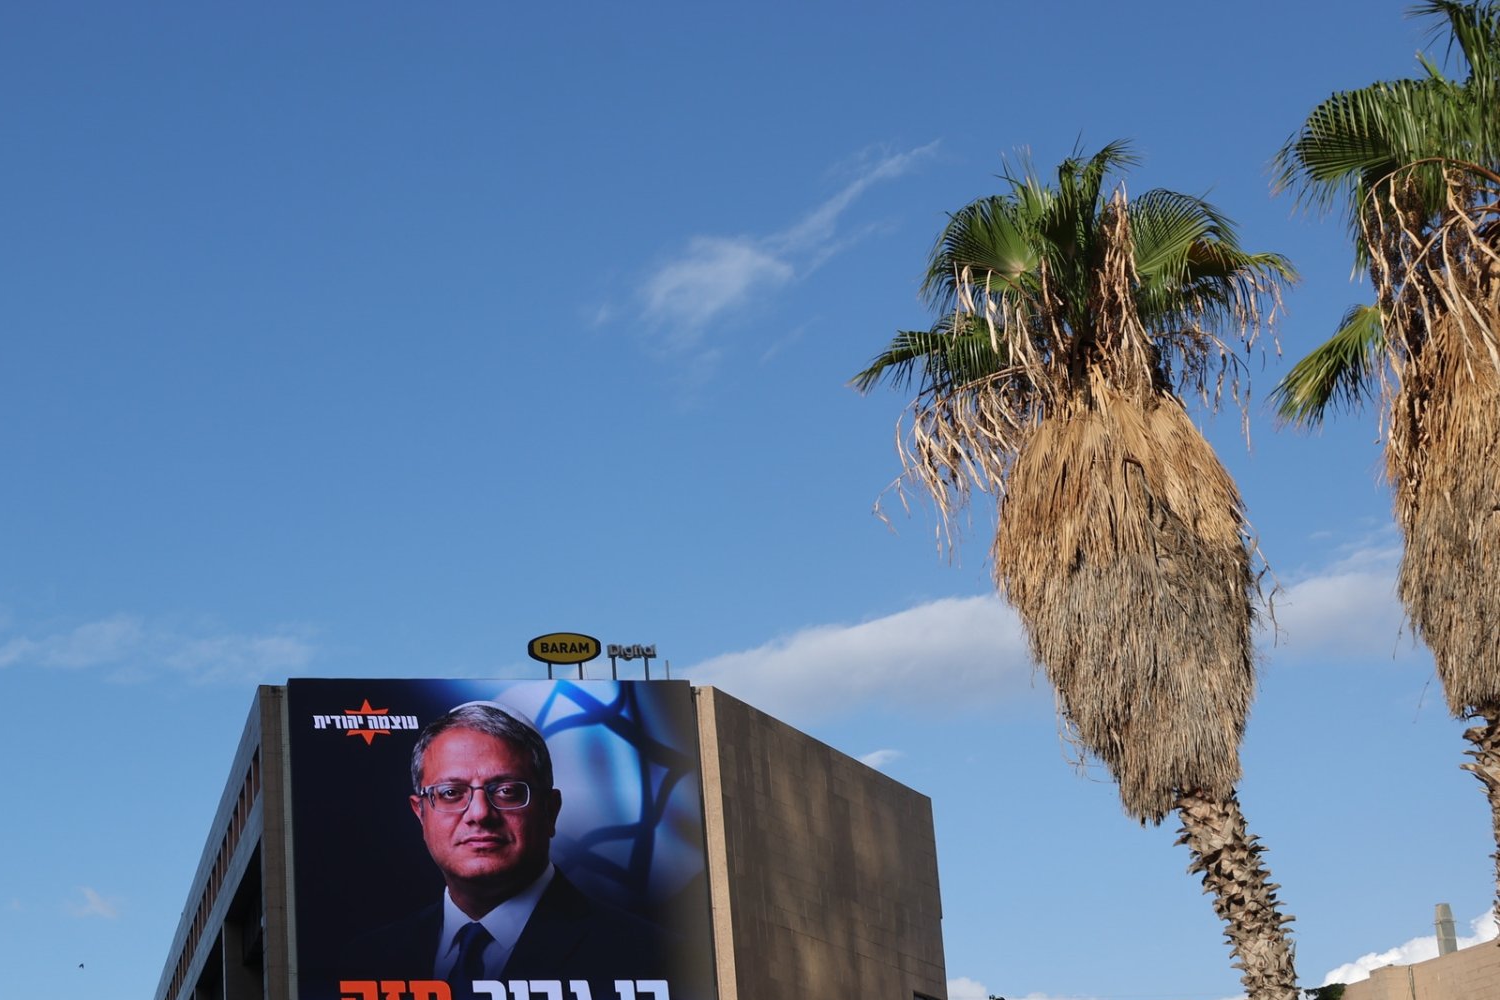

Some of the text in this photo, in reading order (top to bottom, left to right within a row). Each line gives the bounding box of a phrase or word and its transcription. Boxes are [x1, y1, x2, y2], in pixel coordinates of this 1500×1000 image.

[540, 642, 590, 654] BARAM
[607, 643, 657, 661] Digital
[313, 715, 419, 730] עוצמה יהודית
